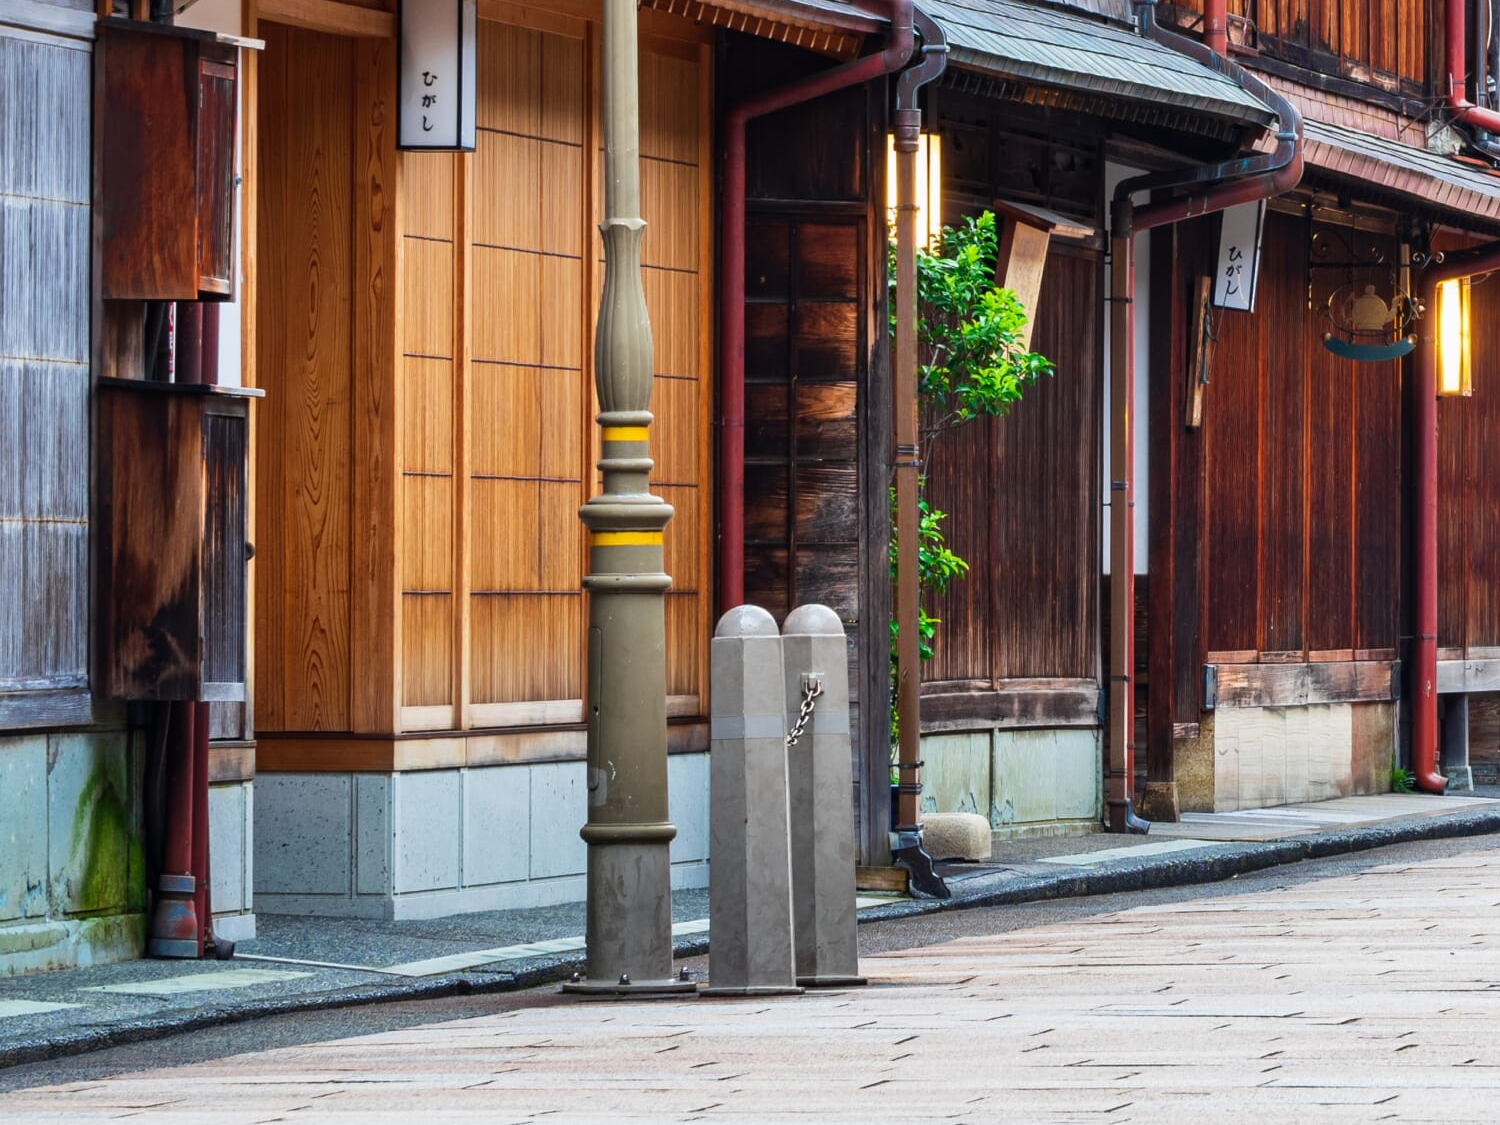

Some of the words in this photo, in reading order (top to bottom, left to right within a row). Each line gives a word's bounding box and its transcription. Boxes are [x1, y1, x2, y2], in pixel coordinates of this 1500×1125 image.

[422, 71, 438, 132] ひがし
[1225, 246, 1243, 295] ひがし
